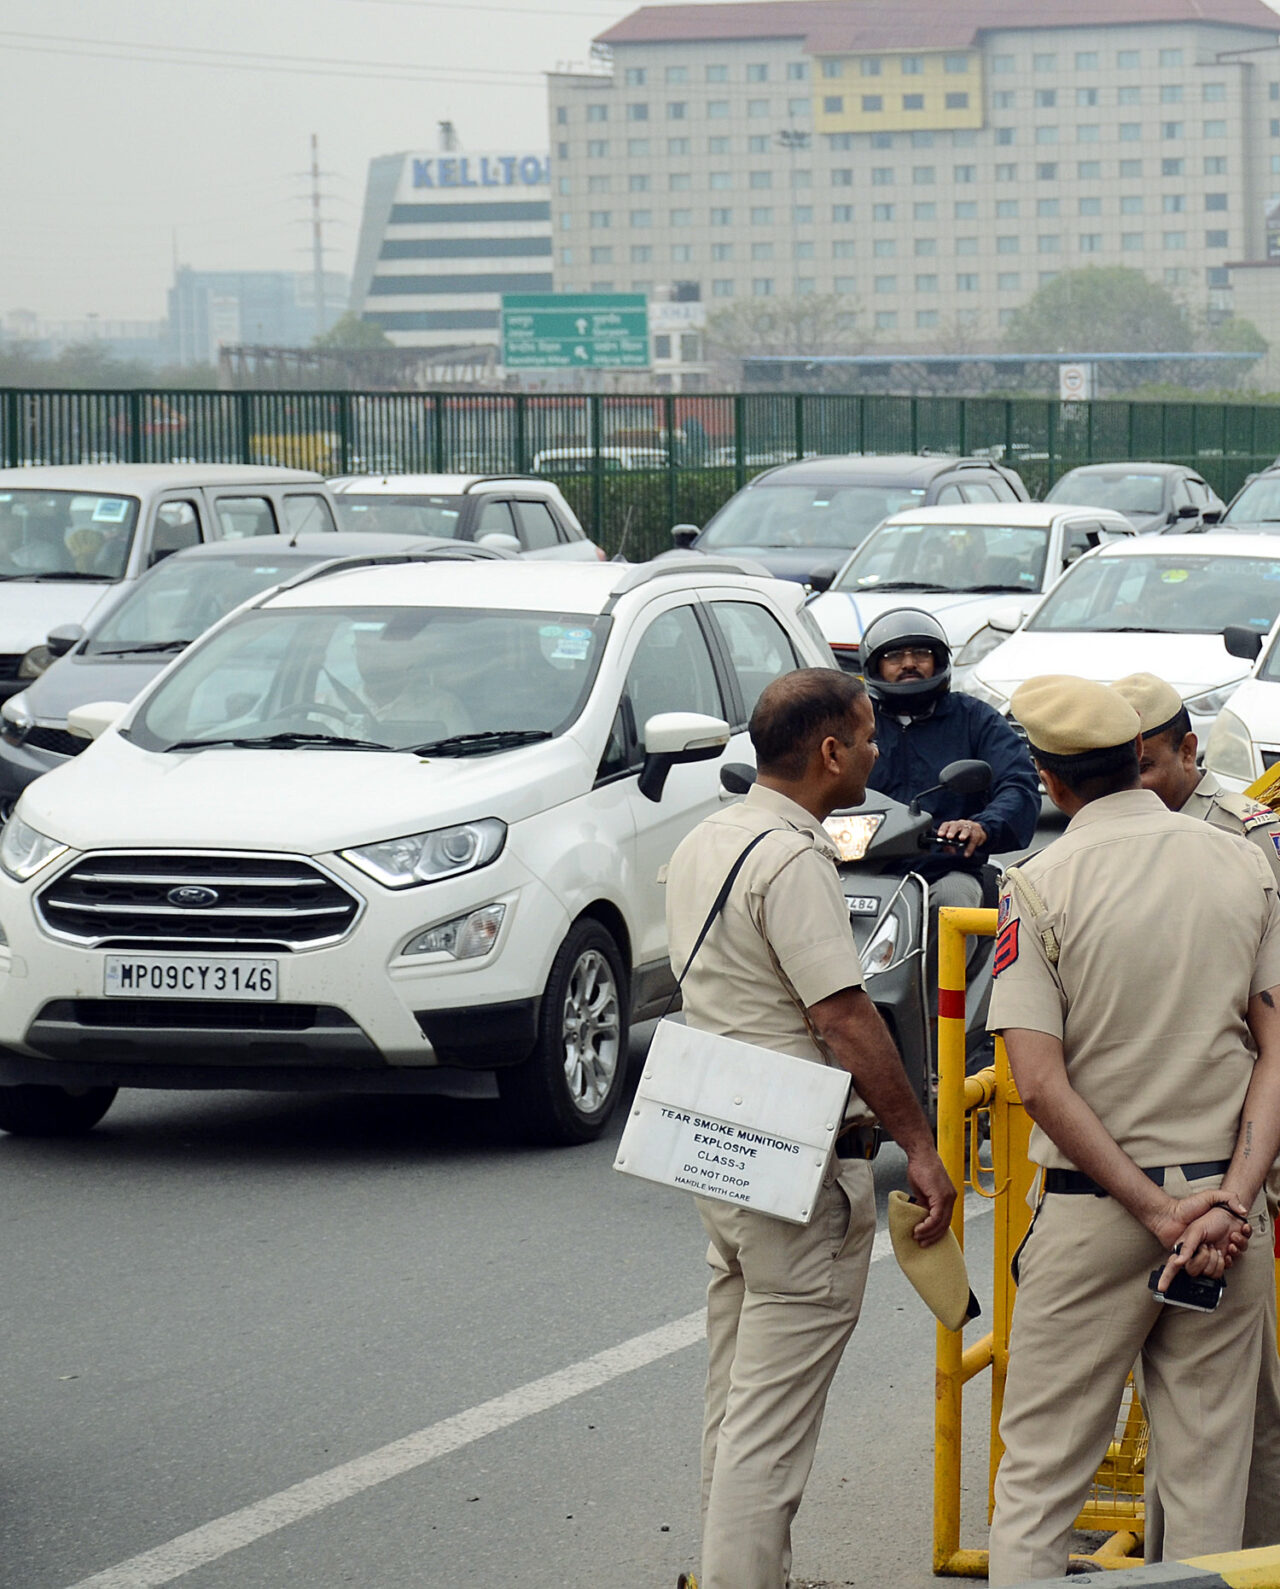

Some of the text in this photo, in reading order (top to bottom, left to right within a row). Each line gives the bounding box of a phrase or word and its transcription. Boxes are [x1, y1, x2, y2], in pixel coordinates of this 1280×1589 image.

[845, 899, 873, 910] 484
[121, 964, 272, 991] MP09CY3146
[661, 1108, 800, 1154] TEAR SMOKE MUNITIONS
[694, 1134, 757, 1158] EXPLOSIVE
[697, 1150, 746, 1170] CLASS-3
[683, 1164, 750, 1188] DO NOT DROP
[674, 1176, 751, 1202] HANDLE WITH CARE
